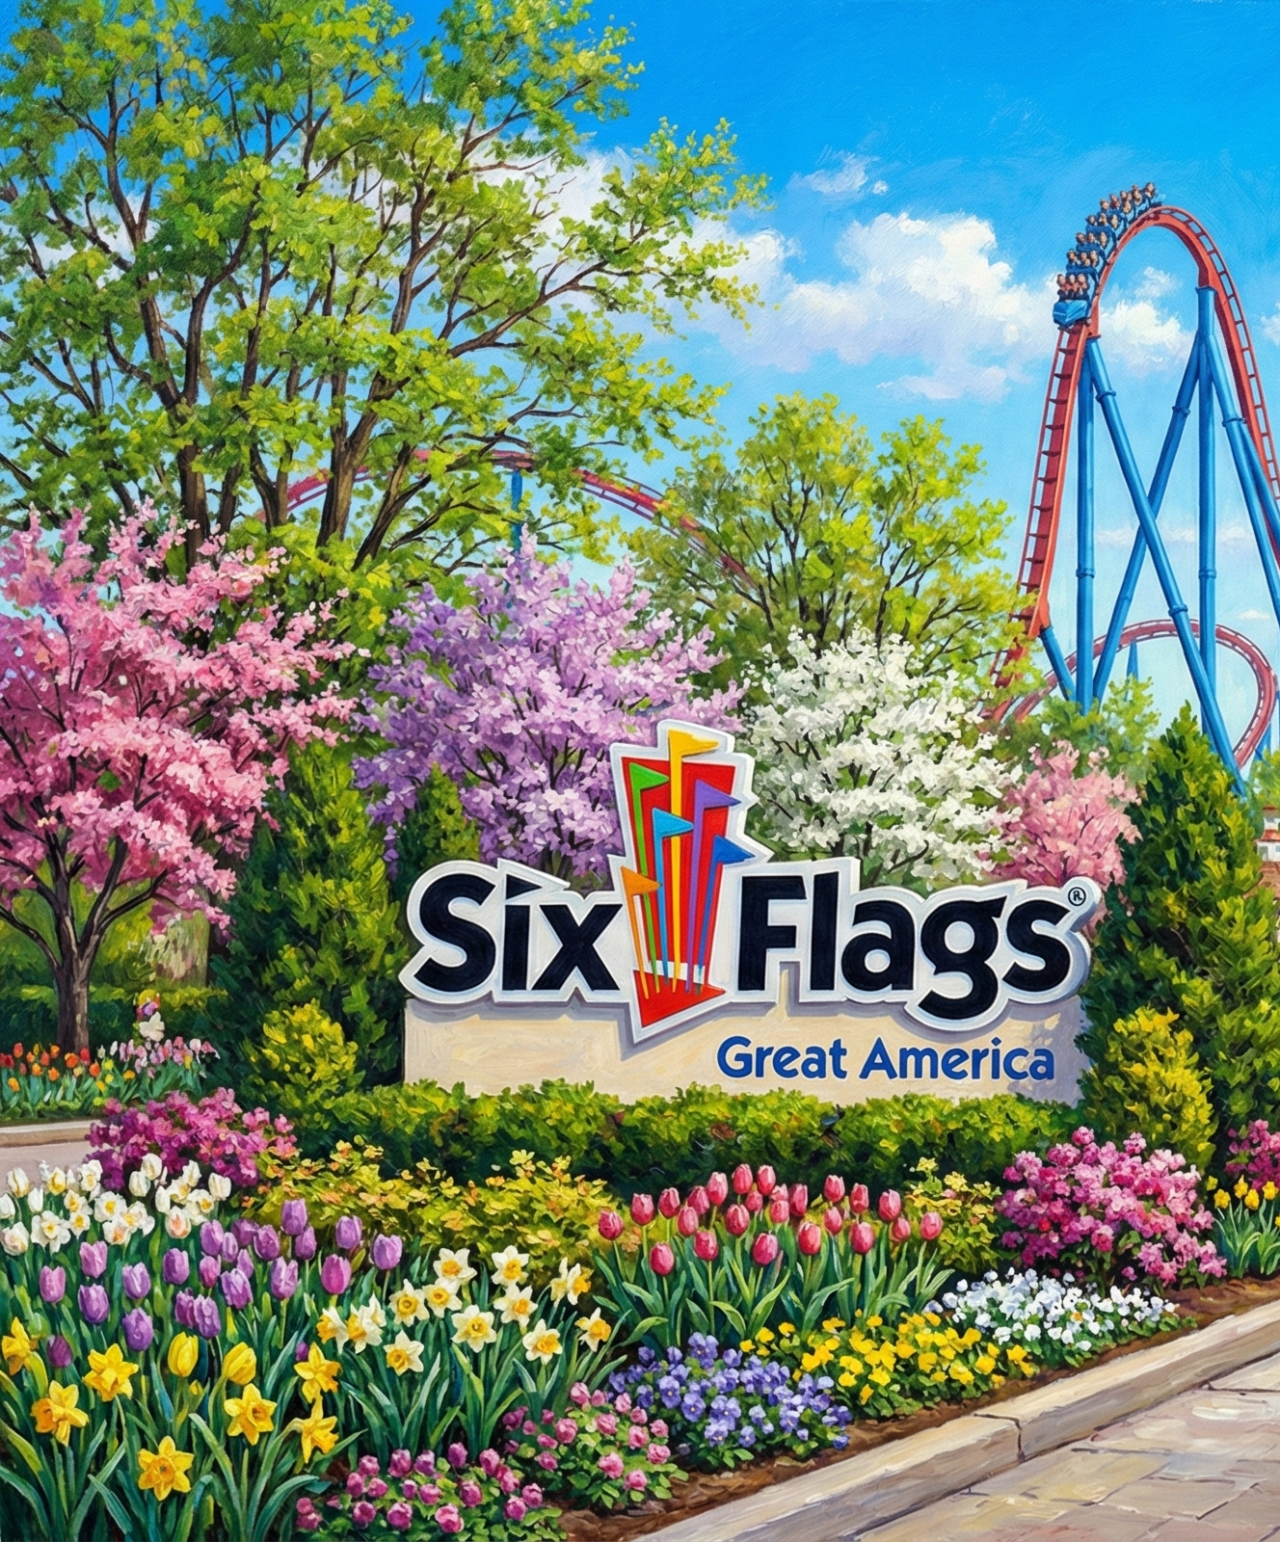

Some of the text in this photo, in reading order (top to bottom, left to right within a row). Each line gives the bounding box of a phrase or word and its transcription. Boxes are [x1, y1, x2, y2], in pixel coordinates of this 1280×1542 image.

[415, 871, 623, 993] Six
[716, 1036, 1056, 1081] Great America
